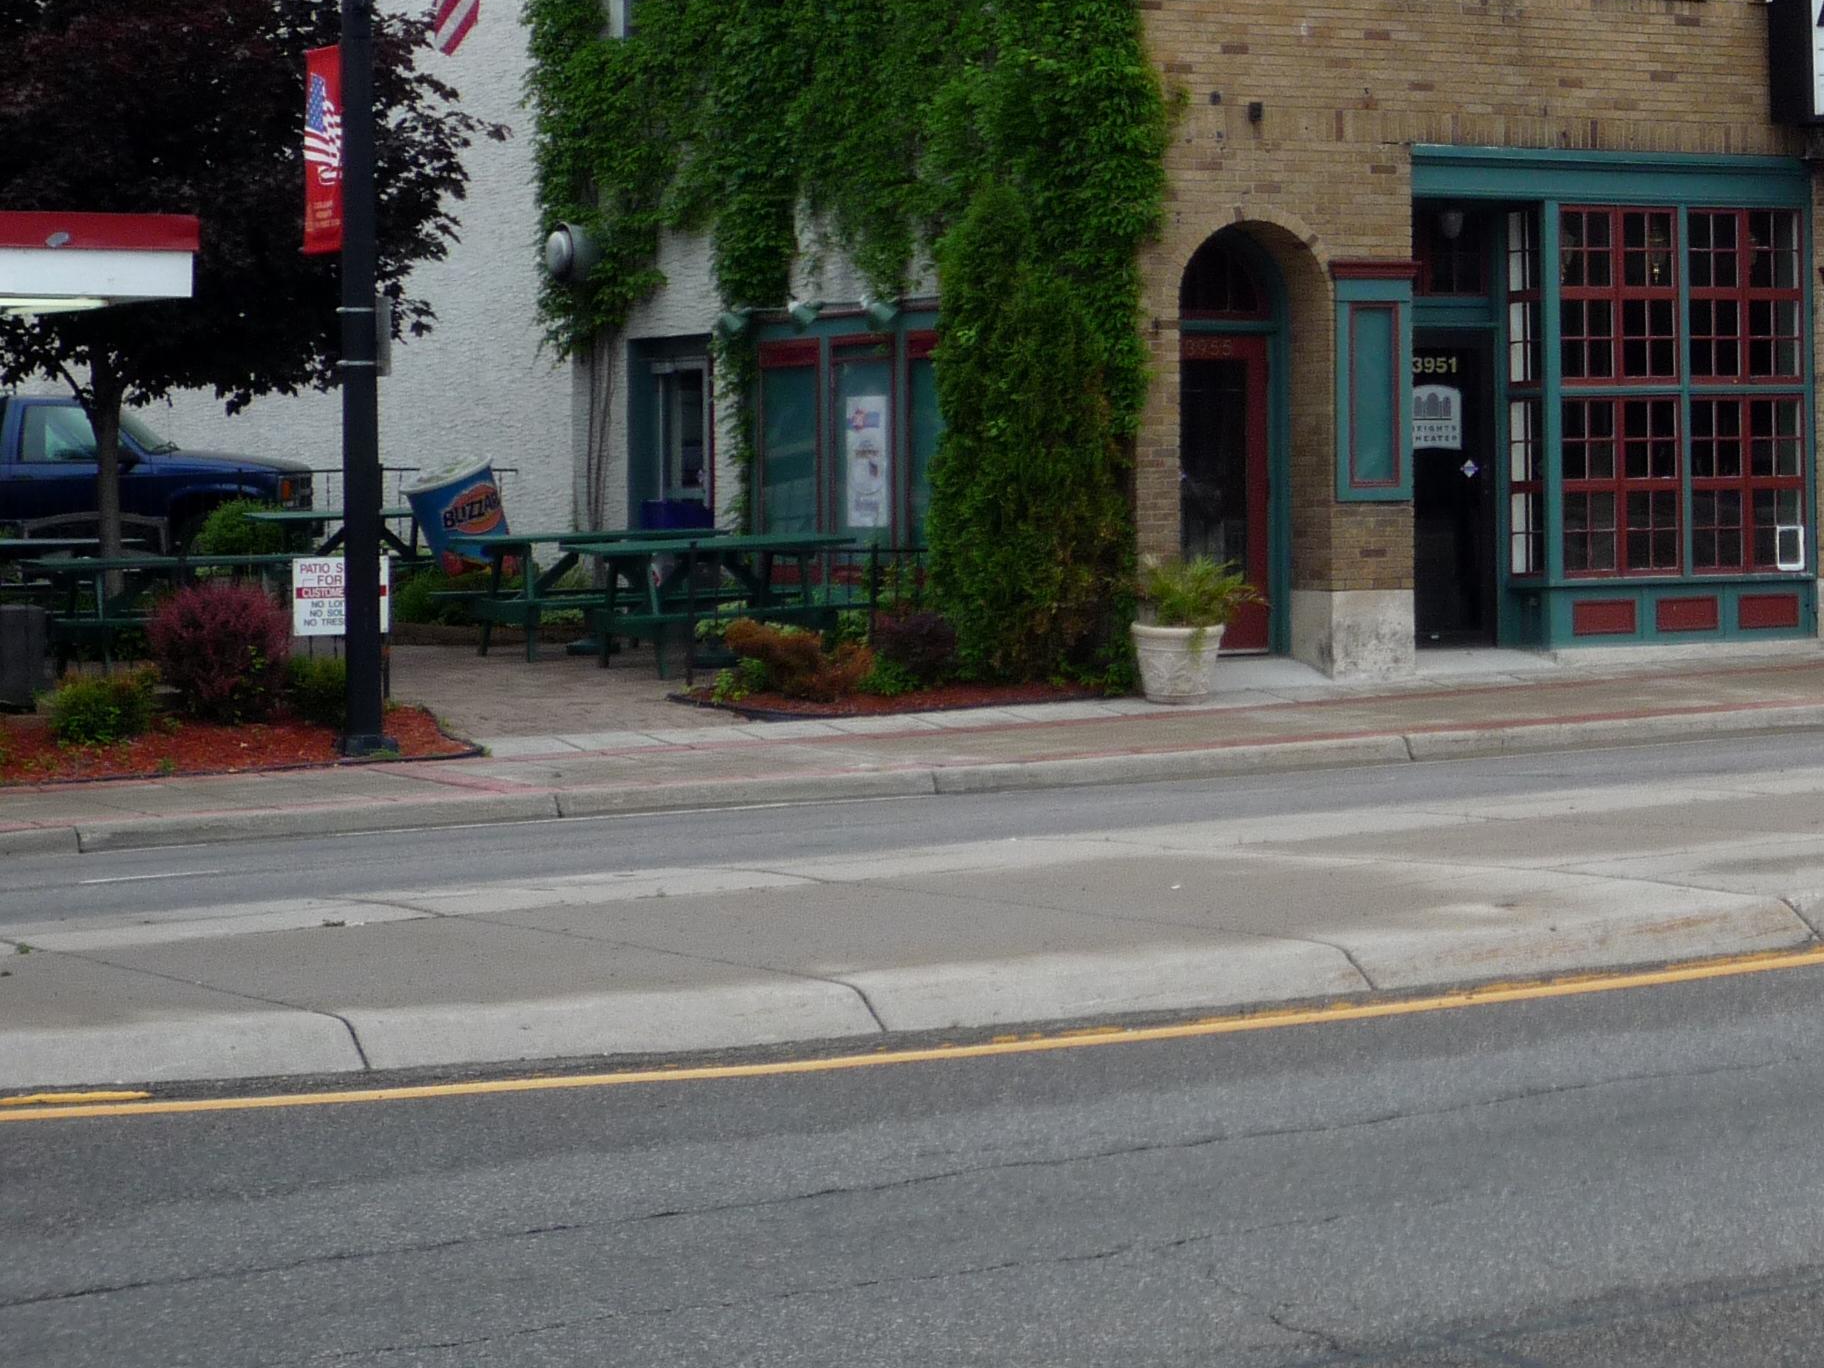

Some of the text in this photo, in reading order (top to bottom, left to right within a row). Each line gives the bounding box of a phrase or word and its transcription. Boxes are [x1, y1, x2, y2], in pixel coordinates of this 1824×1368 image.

[1412, 357, 1458, 374] 3951
[1413, 435, 1458, 443] HEATER
[300, 563, 330, 574] PATIO
[317, 575, 342, 585] FOR
[302, 587, 345, 598] CUSTOME
[311, 600, 324, 608] NO
[309, 609, 323, 618] NO
[303, 619, 317, 627] NO
